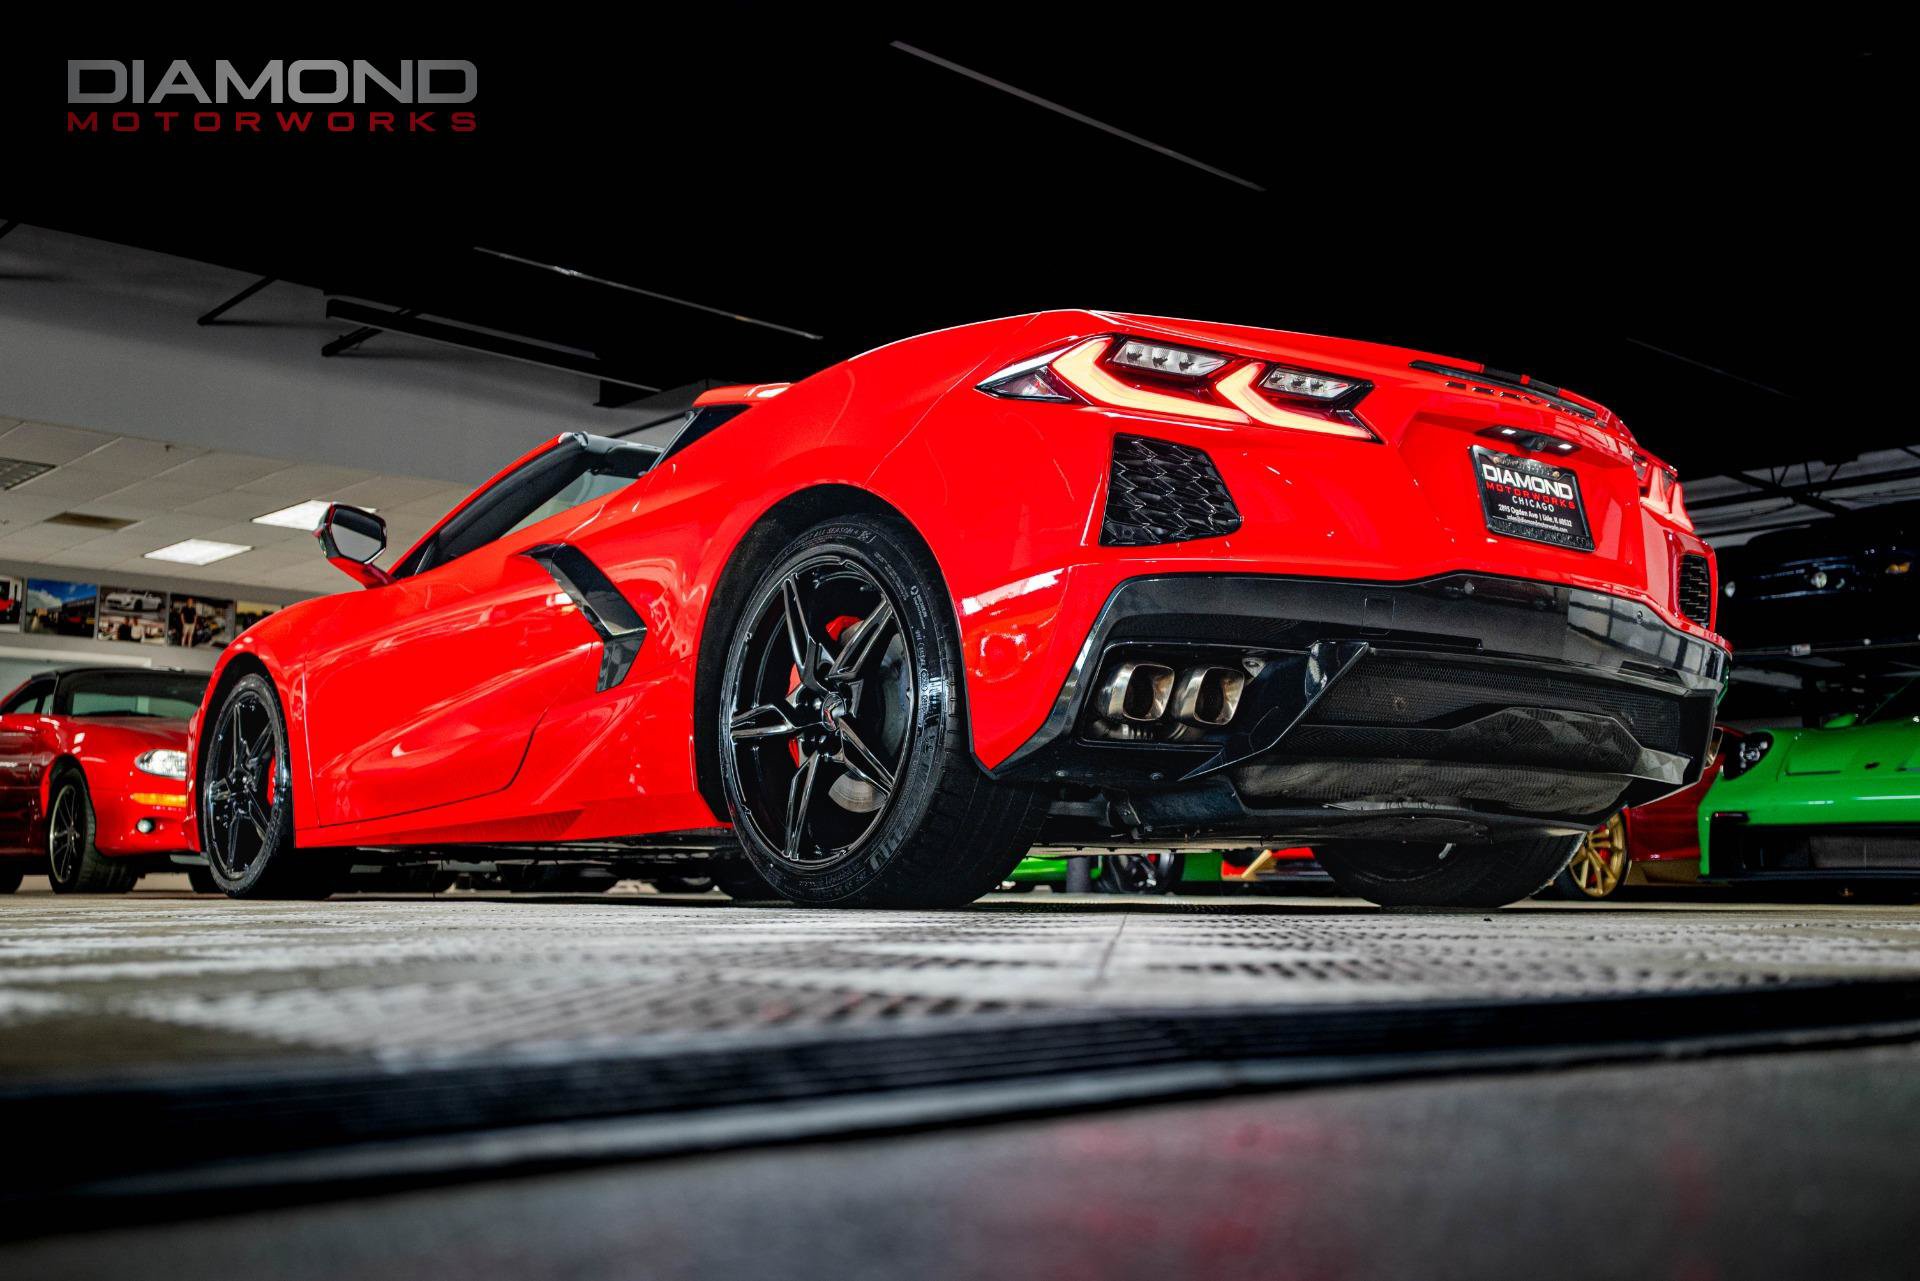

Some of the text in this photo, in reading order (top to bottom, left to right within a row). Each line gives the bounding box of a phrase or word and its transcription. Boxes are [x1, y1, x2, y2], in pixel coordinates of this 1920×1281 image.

[1482, 463, 1574, 500] DIAMOND
[1486, 481, 1575, 509] MOTORWORKS
[1512, 496, 1554, 512] CHICAGO
